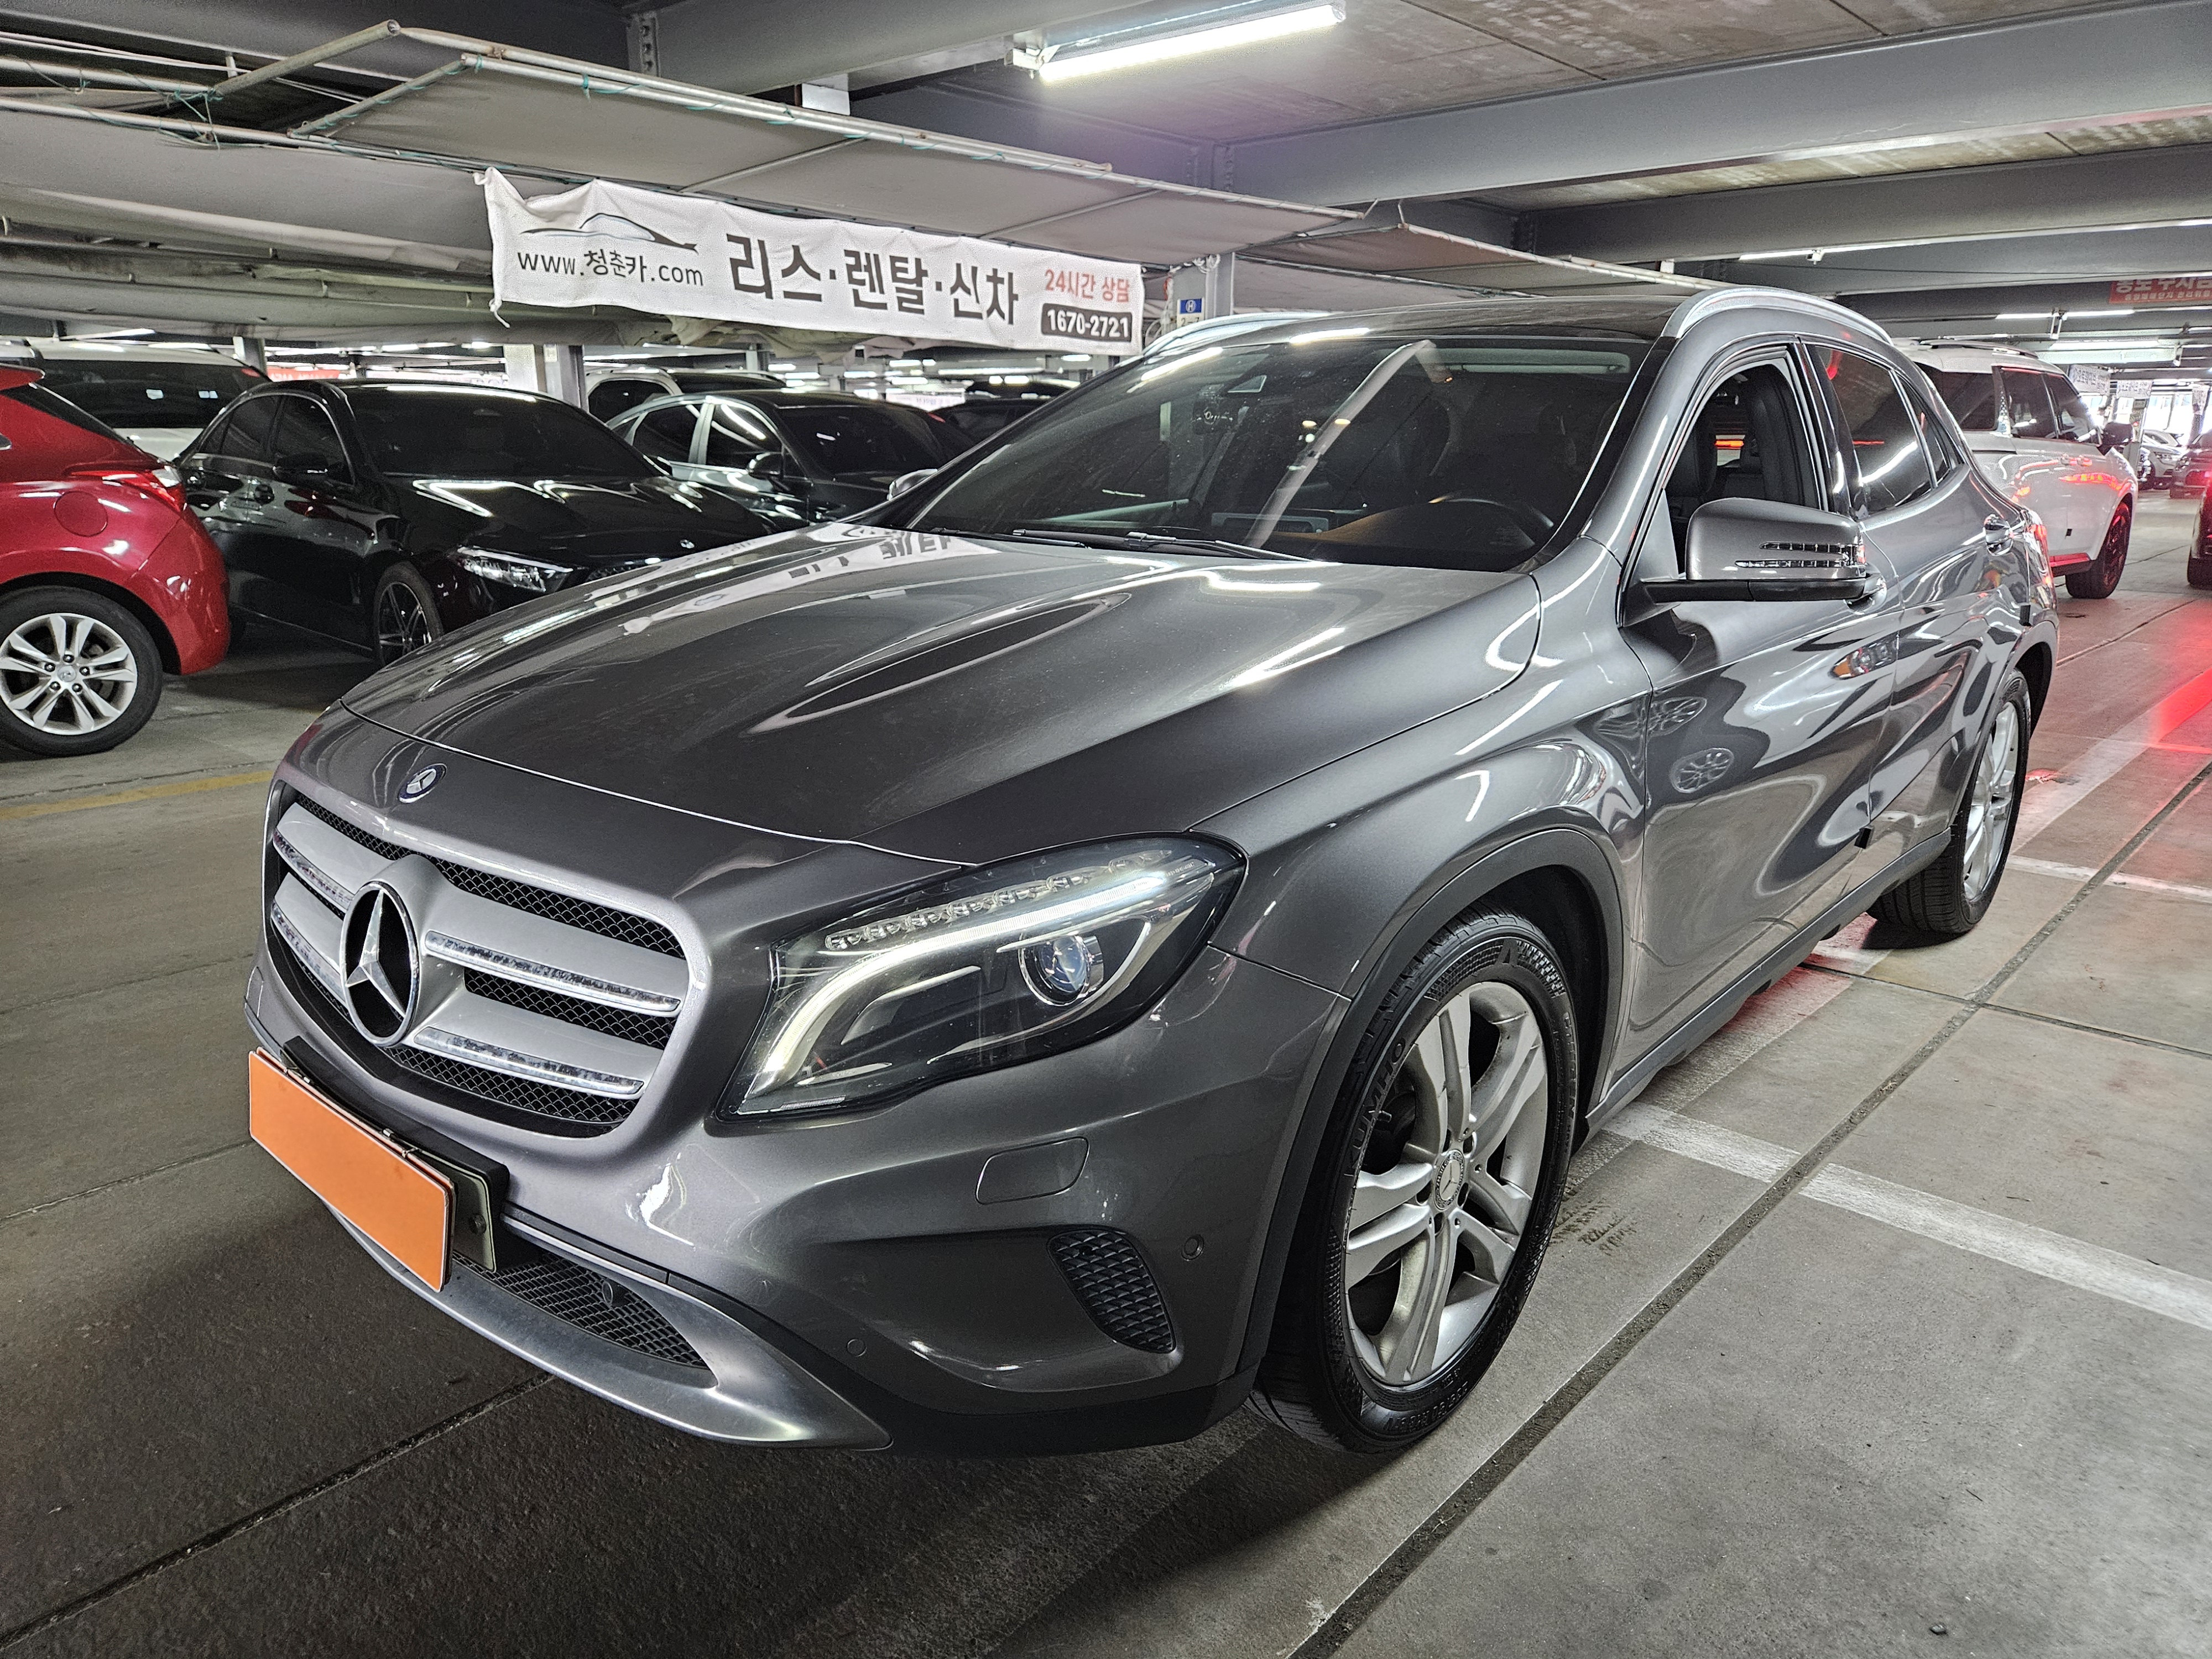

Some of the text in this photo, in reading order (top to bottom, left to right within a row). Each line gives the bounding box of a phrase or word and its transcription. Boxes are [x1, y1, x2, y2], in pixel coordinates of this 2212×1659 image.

[517, 248, 704, 286] www.청춘카.com
[1045, 268, 1130, 302] 24시간 상담
[1047, 308, 1129, 338] 1670-2721
